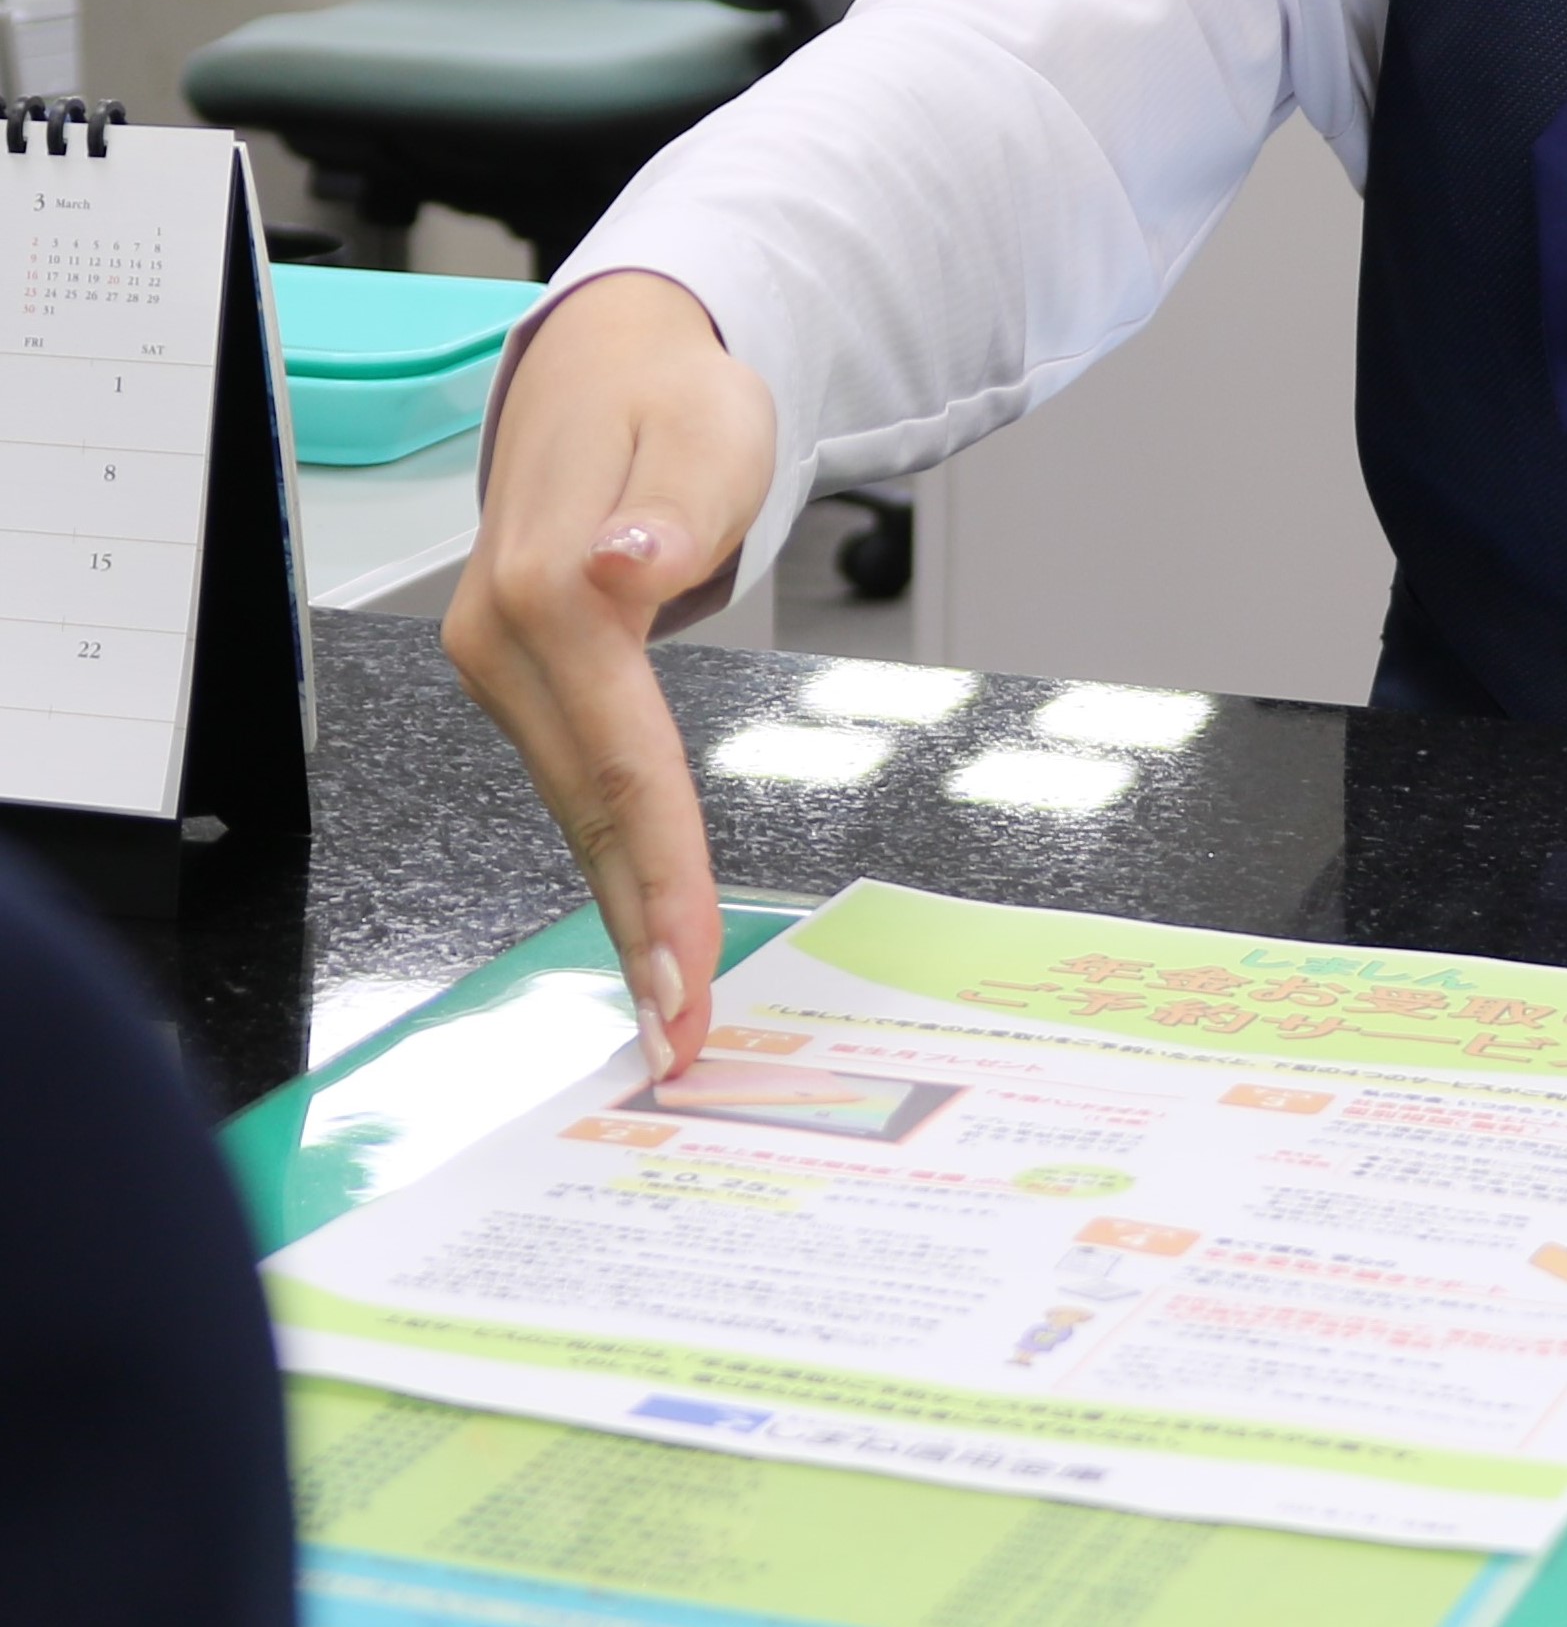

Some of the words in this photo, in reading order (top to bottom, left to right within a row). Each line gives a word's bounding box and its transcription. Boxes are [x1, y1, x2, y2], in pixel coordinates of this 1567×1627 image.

[33, 192, 46, 212] 3
[55, 198, 91, 211] March
[48, 254, 61, 265] 10
[68, 255, 80, 266] 11
[89, 256, 101, 267] 12
[109, 258, 122, 269] 13
[130, 259, 142, 270] 14
[150, 260, 163, 271] 15
[26, 270, 39, 281] 16
[47, 271, 59, 282] 17
[67, 272, 80, 283] 18
[87, 273, 101, 284] 19
[107, 275, 120, 286] 20
[127, 276, 140, 287] 21
[147, 277, 161, 288] 22
[24, 287, 37, 298] 23
[44, 288, 57, 299] 24
[64, 289, 78, 300] 25
[85, 290, 99, 301] 26
[105, 291, 119, 302] 27
[126, 293, 140, 304] 28
[146, 294, 161, 305] 29
[22, 304, 36, 315] 30
[42, 305, 55, 316] 31
[24, 336, 44, 348] FRI
[141, 344, 166, 356] SAT
[113, 375, 124, 394] 1
[103, 464, 117, 482] 8
[89, 552, 113, 572] 15
[76, 640, 102, 660] 22
[1234, 947, 1493, 991] しましん
[766, 1418, 1113, 1483] しまね信用金庫
